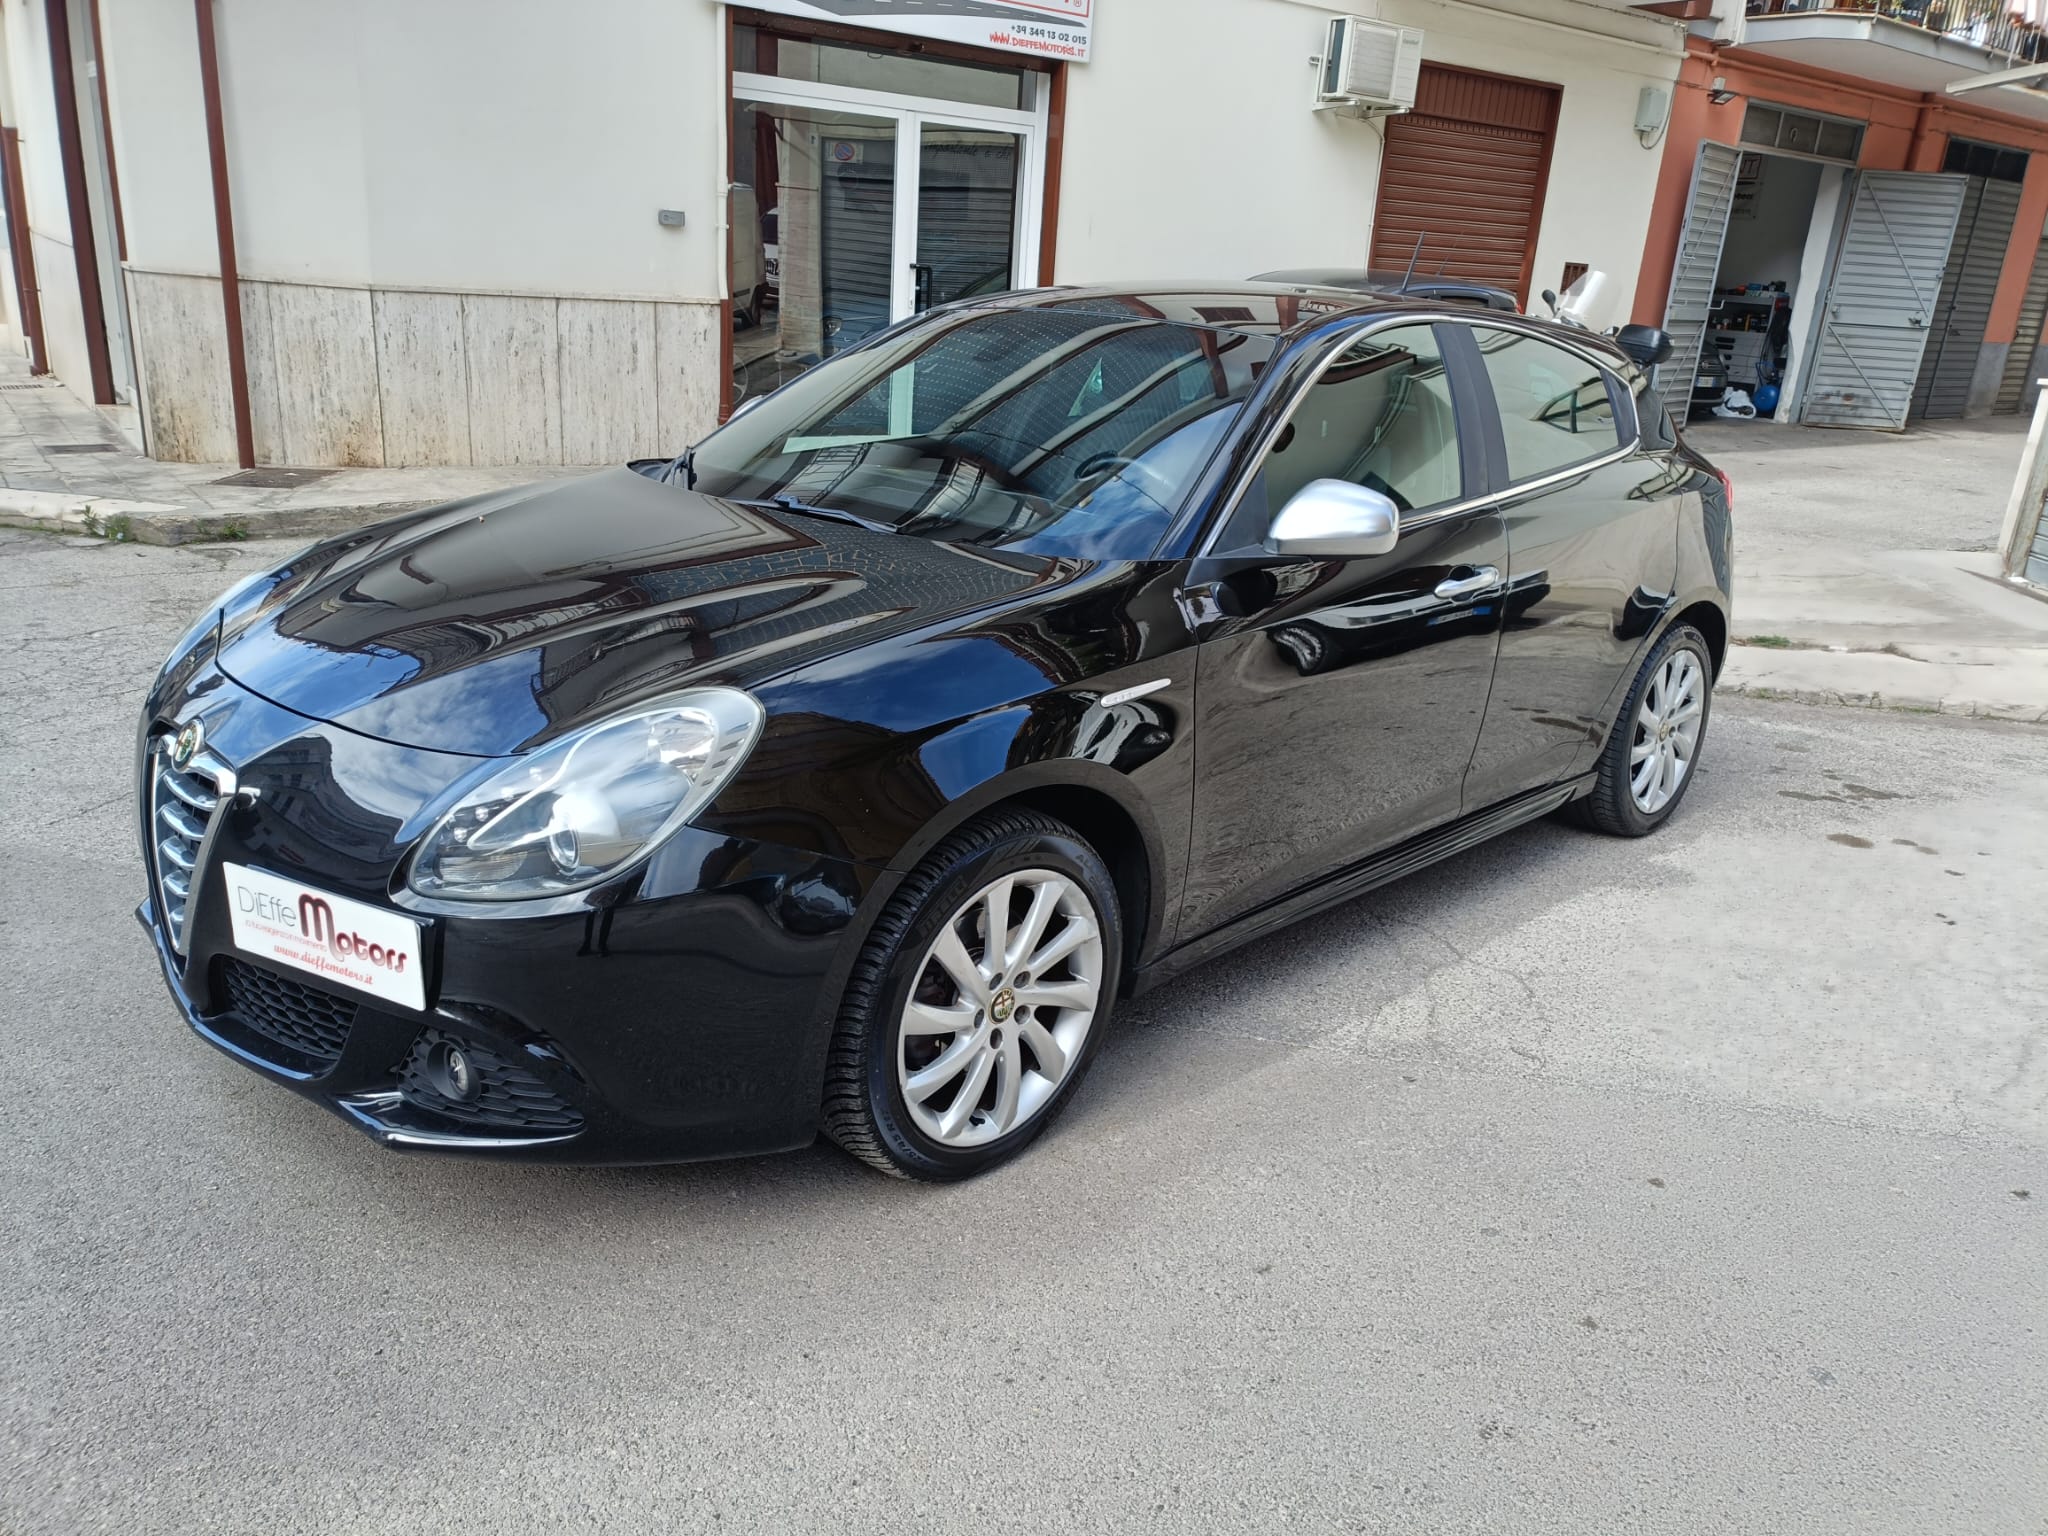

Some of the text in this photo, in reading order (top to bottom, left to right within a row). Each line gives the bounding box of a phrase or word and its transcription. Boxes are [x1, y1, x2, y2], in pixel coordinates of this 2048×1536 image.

[1011, 25, 1087, 45] +39 349 13 02 015
[237, 886, 296, 927] DiEffe
[298, 893, 407, 973] Motors
[274, 945, 373, 984] www.dieffemotors.it
